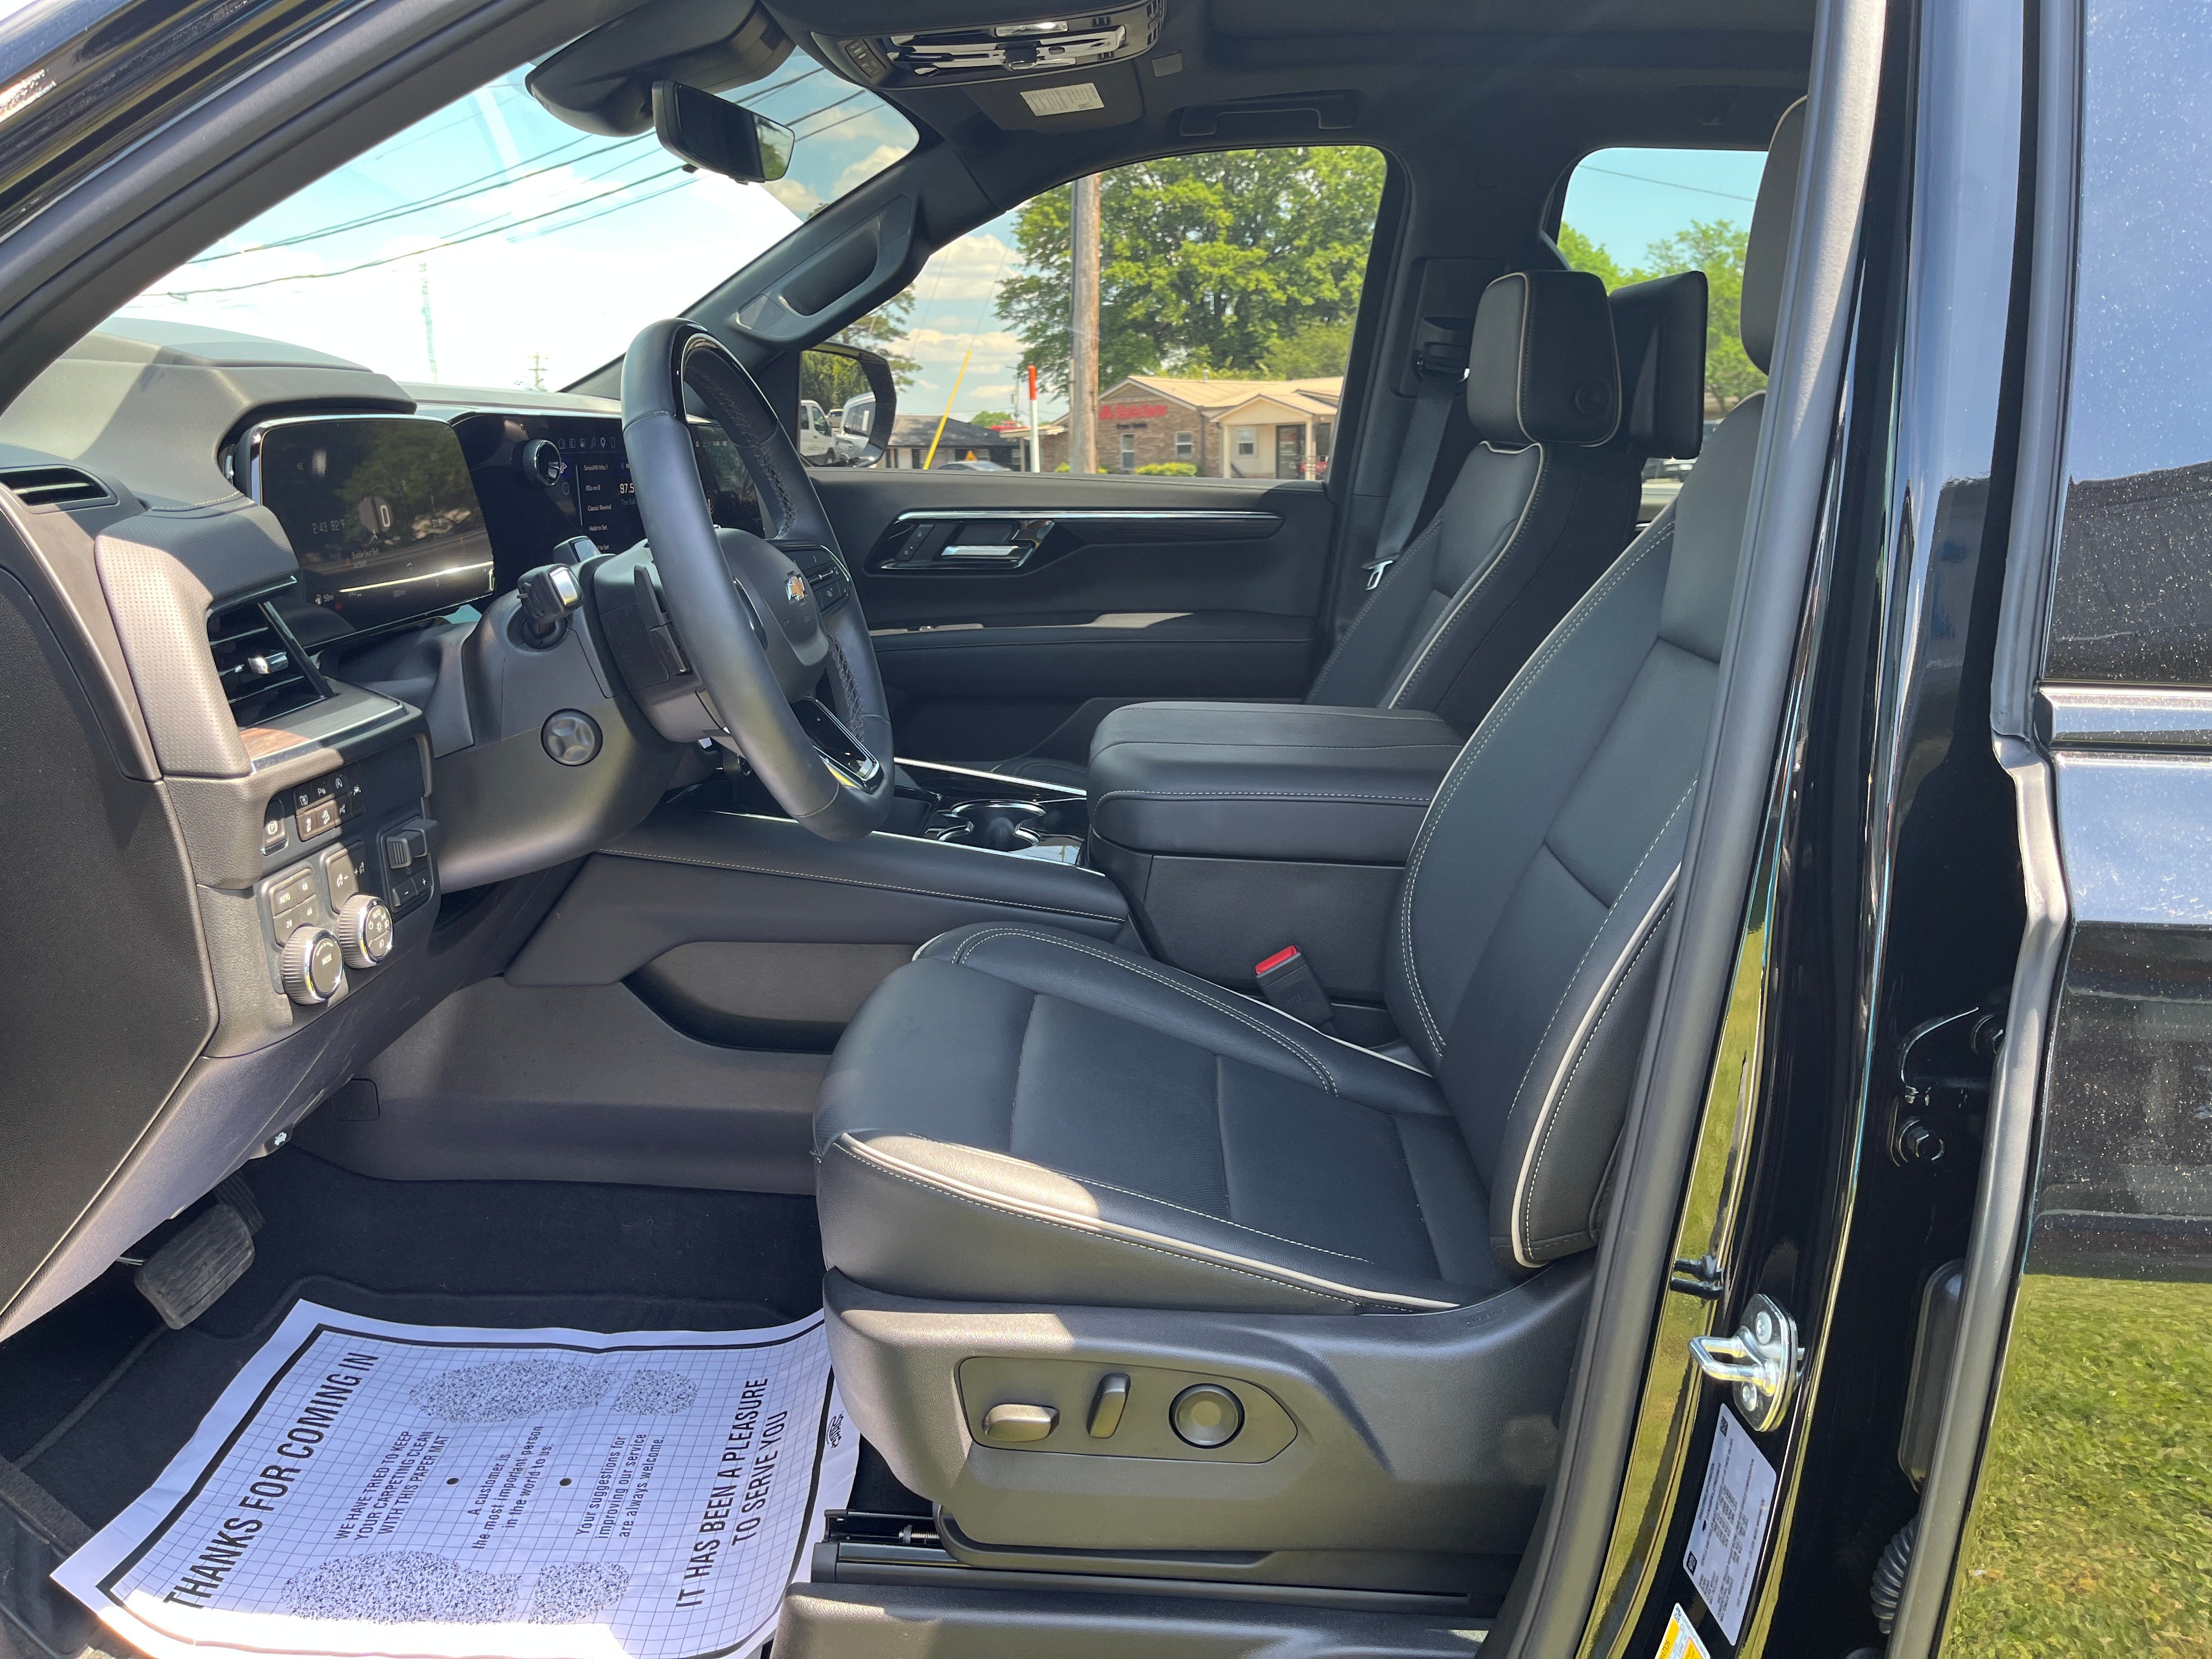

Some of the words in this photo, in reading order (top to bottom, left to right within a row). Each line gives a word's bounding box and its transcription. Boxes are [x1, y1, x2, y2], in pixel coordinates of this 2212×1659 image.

[620, 483, 634, 494] 97.5
[313, 522, 328, 534] 2:43
[380, 505, 391, 527] 0
[280, 893, 291, 904] AUTO
[322, 953, 332, 966] MODE
[722, 1378, 768, 1462] PLEASURE
[758, 1410, 788, 1451] YOU
[531, 1458, 546, 1469] to
[539, 1443, 554, 1456] us.
[625, 1434, 646, 1466] service
[640, 1436, 665, 1480] welcome.
[162, 1517, 263, 1610] THANKS
[238, 1465, 302, 1511] FOR
[277, 1374, 363, 1459] COMING
[338, 1352, 379, 1372] IN
[334, 1523, 356, 1539] WE
[346, 1496, 373, 1520] HAVE
[362, 1467, 390, 1494] TRIED
[381, 1453, 399, 1465] TO
[391, 1431, 413, 1451] KEEP
[353, 1511, 383, 1541] YOUR
[374, 1459, 415, 1509] CARPETING
[407, 1431, 435, 1457] CLEAN
[377, 1508, 405, 1535] WITH
[394, 1485, 419, 1505] THIS
[409, 1454, 438, 1482] PAPER
[428, 1435, 449, 1453] MAT
[471, 1533, 490, 1549] the
[483, 1504, 504, 1530] most
[494, 1458, 528, 1501] important
[521, 1426, 544, 1455] person
[475, 1463, 505, 1505] customer
[520, 1471, 541, 1496] world
[575, 1511, 596, 1536] Your
[589, 1452, 620, 1509] suggestions
[610, 1436, 627, 1448] for
[618, 1469, 633, 1485] our
[716, 1466, 743, 1479] A
[741, 1450, 778, 1514] SERVE
[508, 1499, 527, 1515] the
[594, 1488, 629, 1538] improving
[625, 1482, 648, 1516] always
[699, 1485, 737, 1533] BEEN
[502, 1519, 518, 1528] in
[619, 1520, 634, 1537] are
[731, 1516, 761, 1547] TO
[684, 1539, 721, 1580] HAS
[675, 1588, 706, 1607] IT
